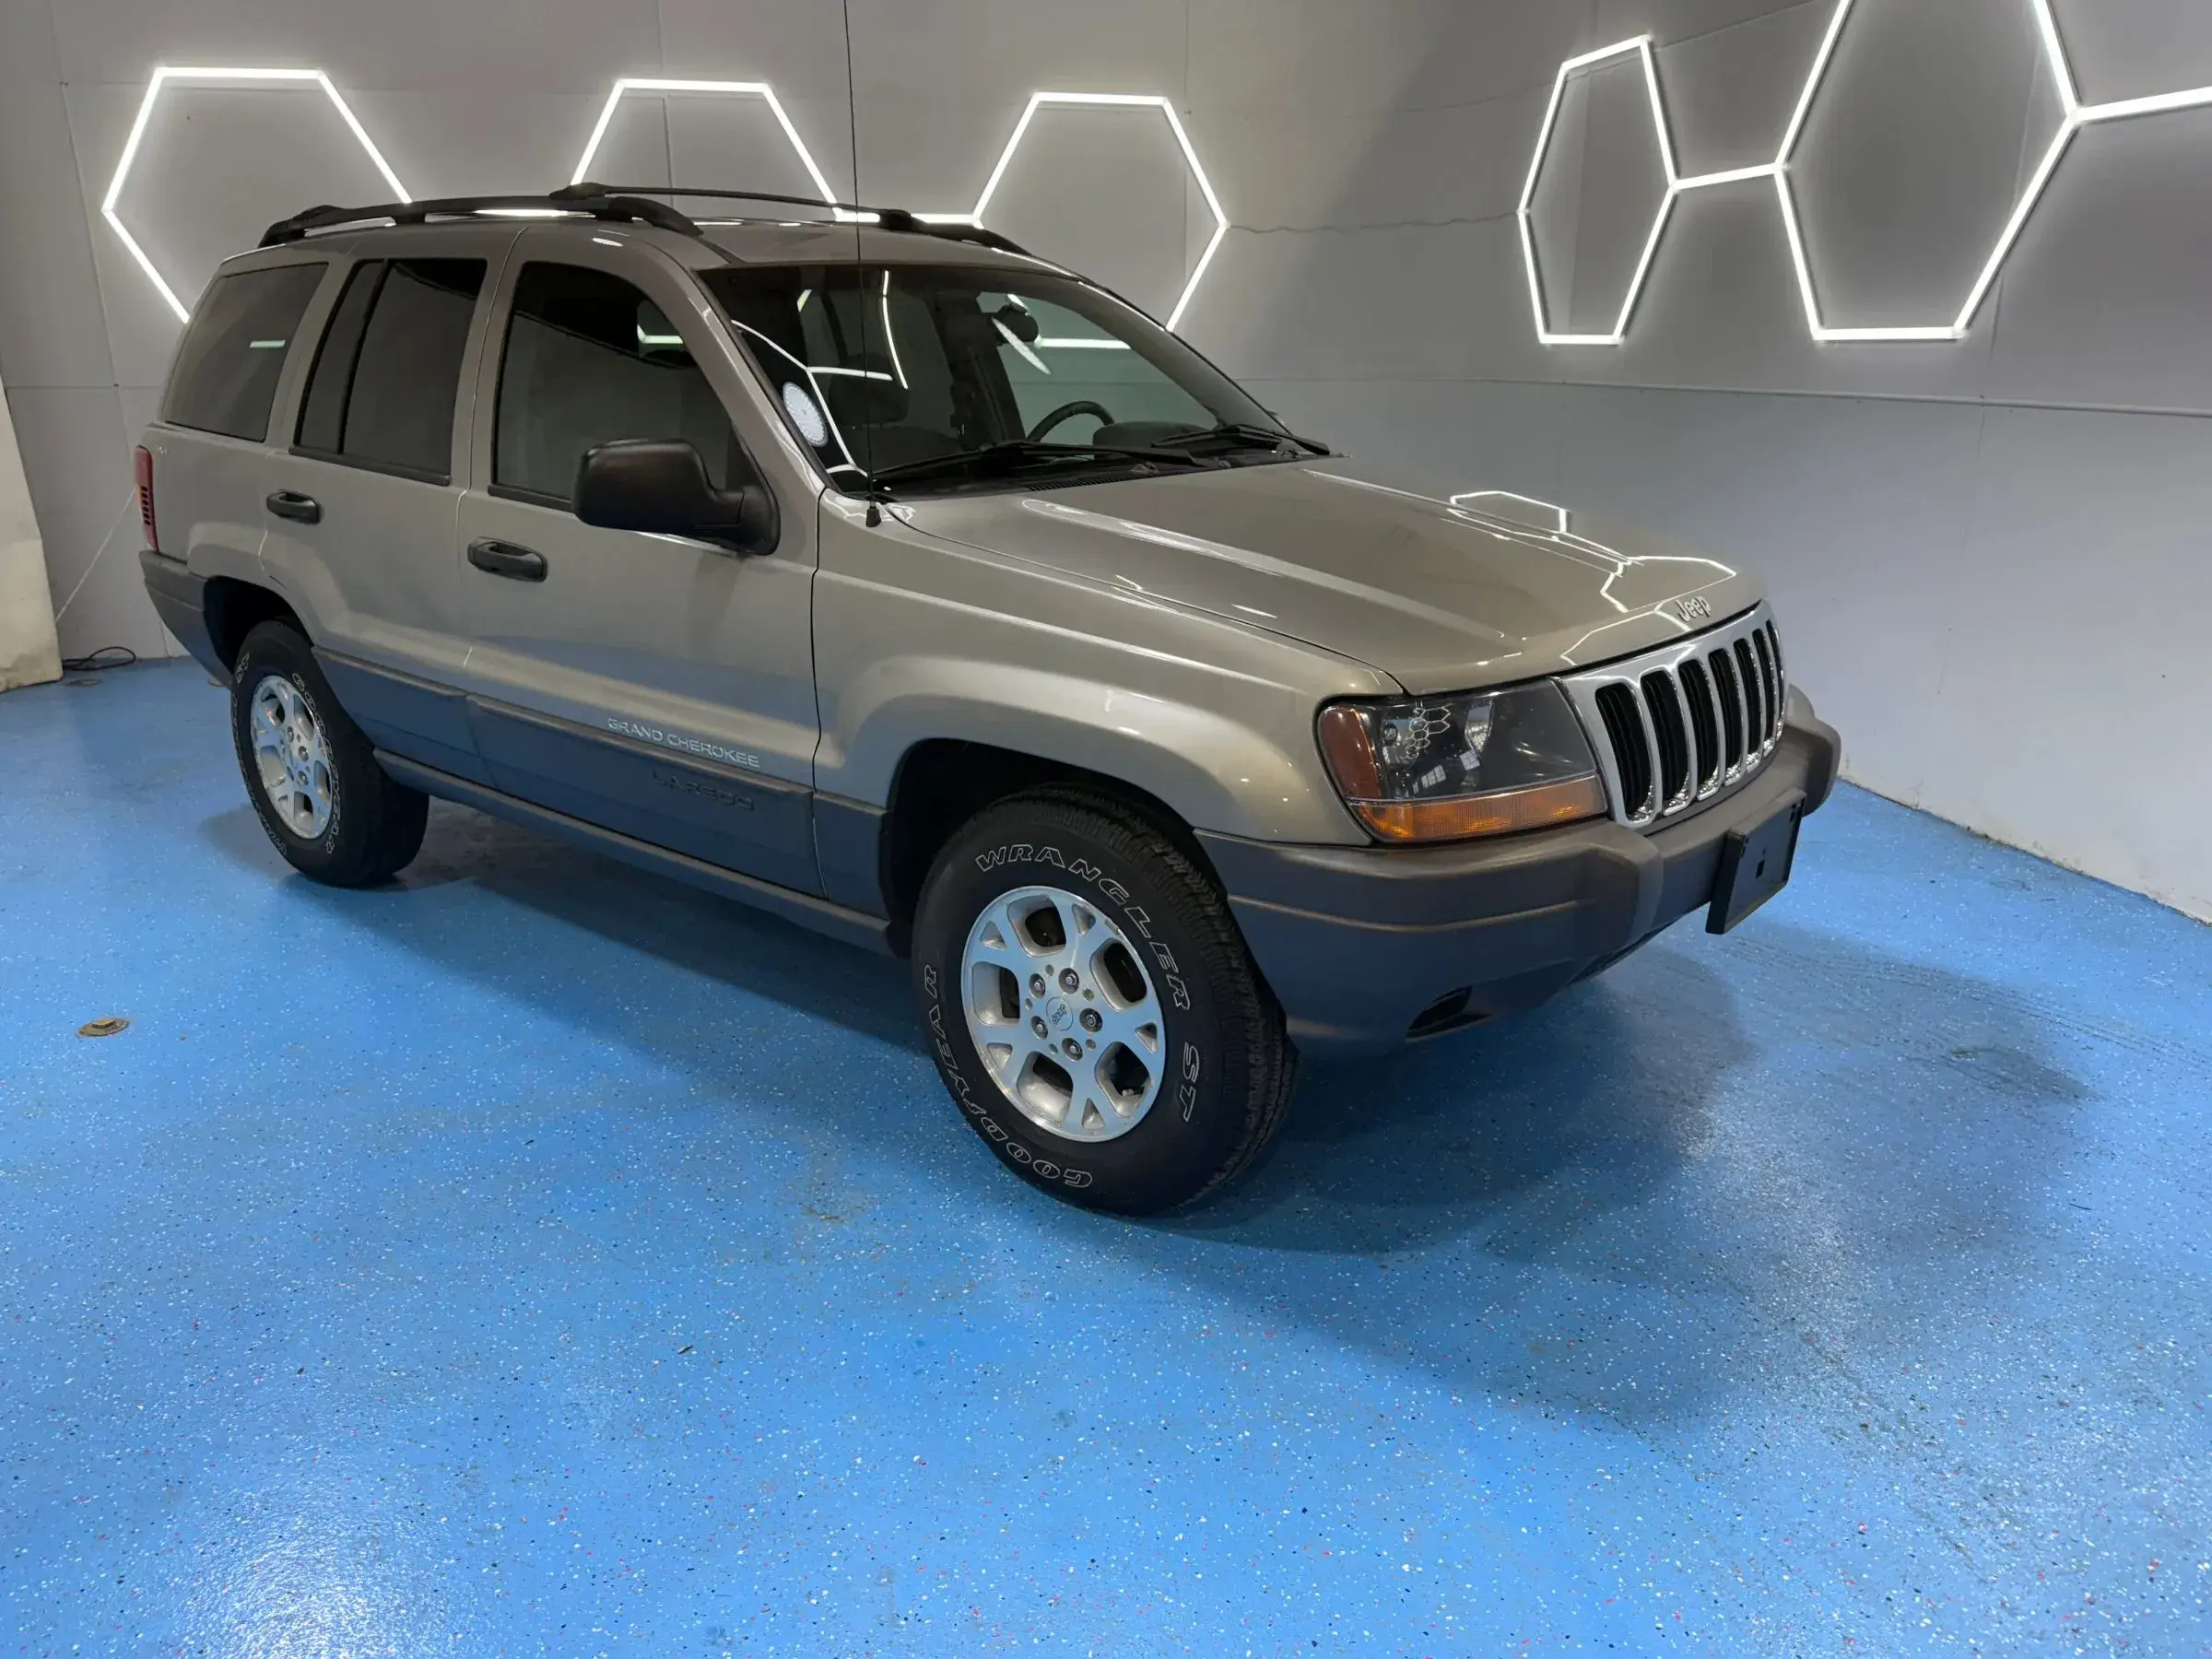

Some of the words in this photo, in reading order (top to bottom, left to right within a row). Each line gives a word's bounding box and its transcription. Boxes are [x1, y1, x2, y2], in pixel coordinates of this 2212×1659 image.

[1675, 596, 1712, 622] Jeep
[606, 717, 663, 743] GRAND
[666, 734, 760, 768] CHEROKEE
[975, 843, 1191, 1012] WRANGLER
[1178, 1041, 1200, 1123] ST
[924, 964, 1093, 1188] GOODYEAR
